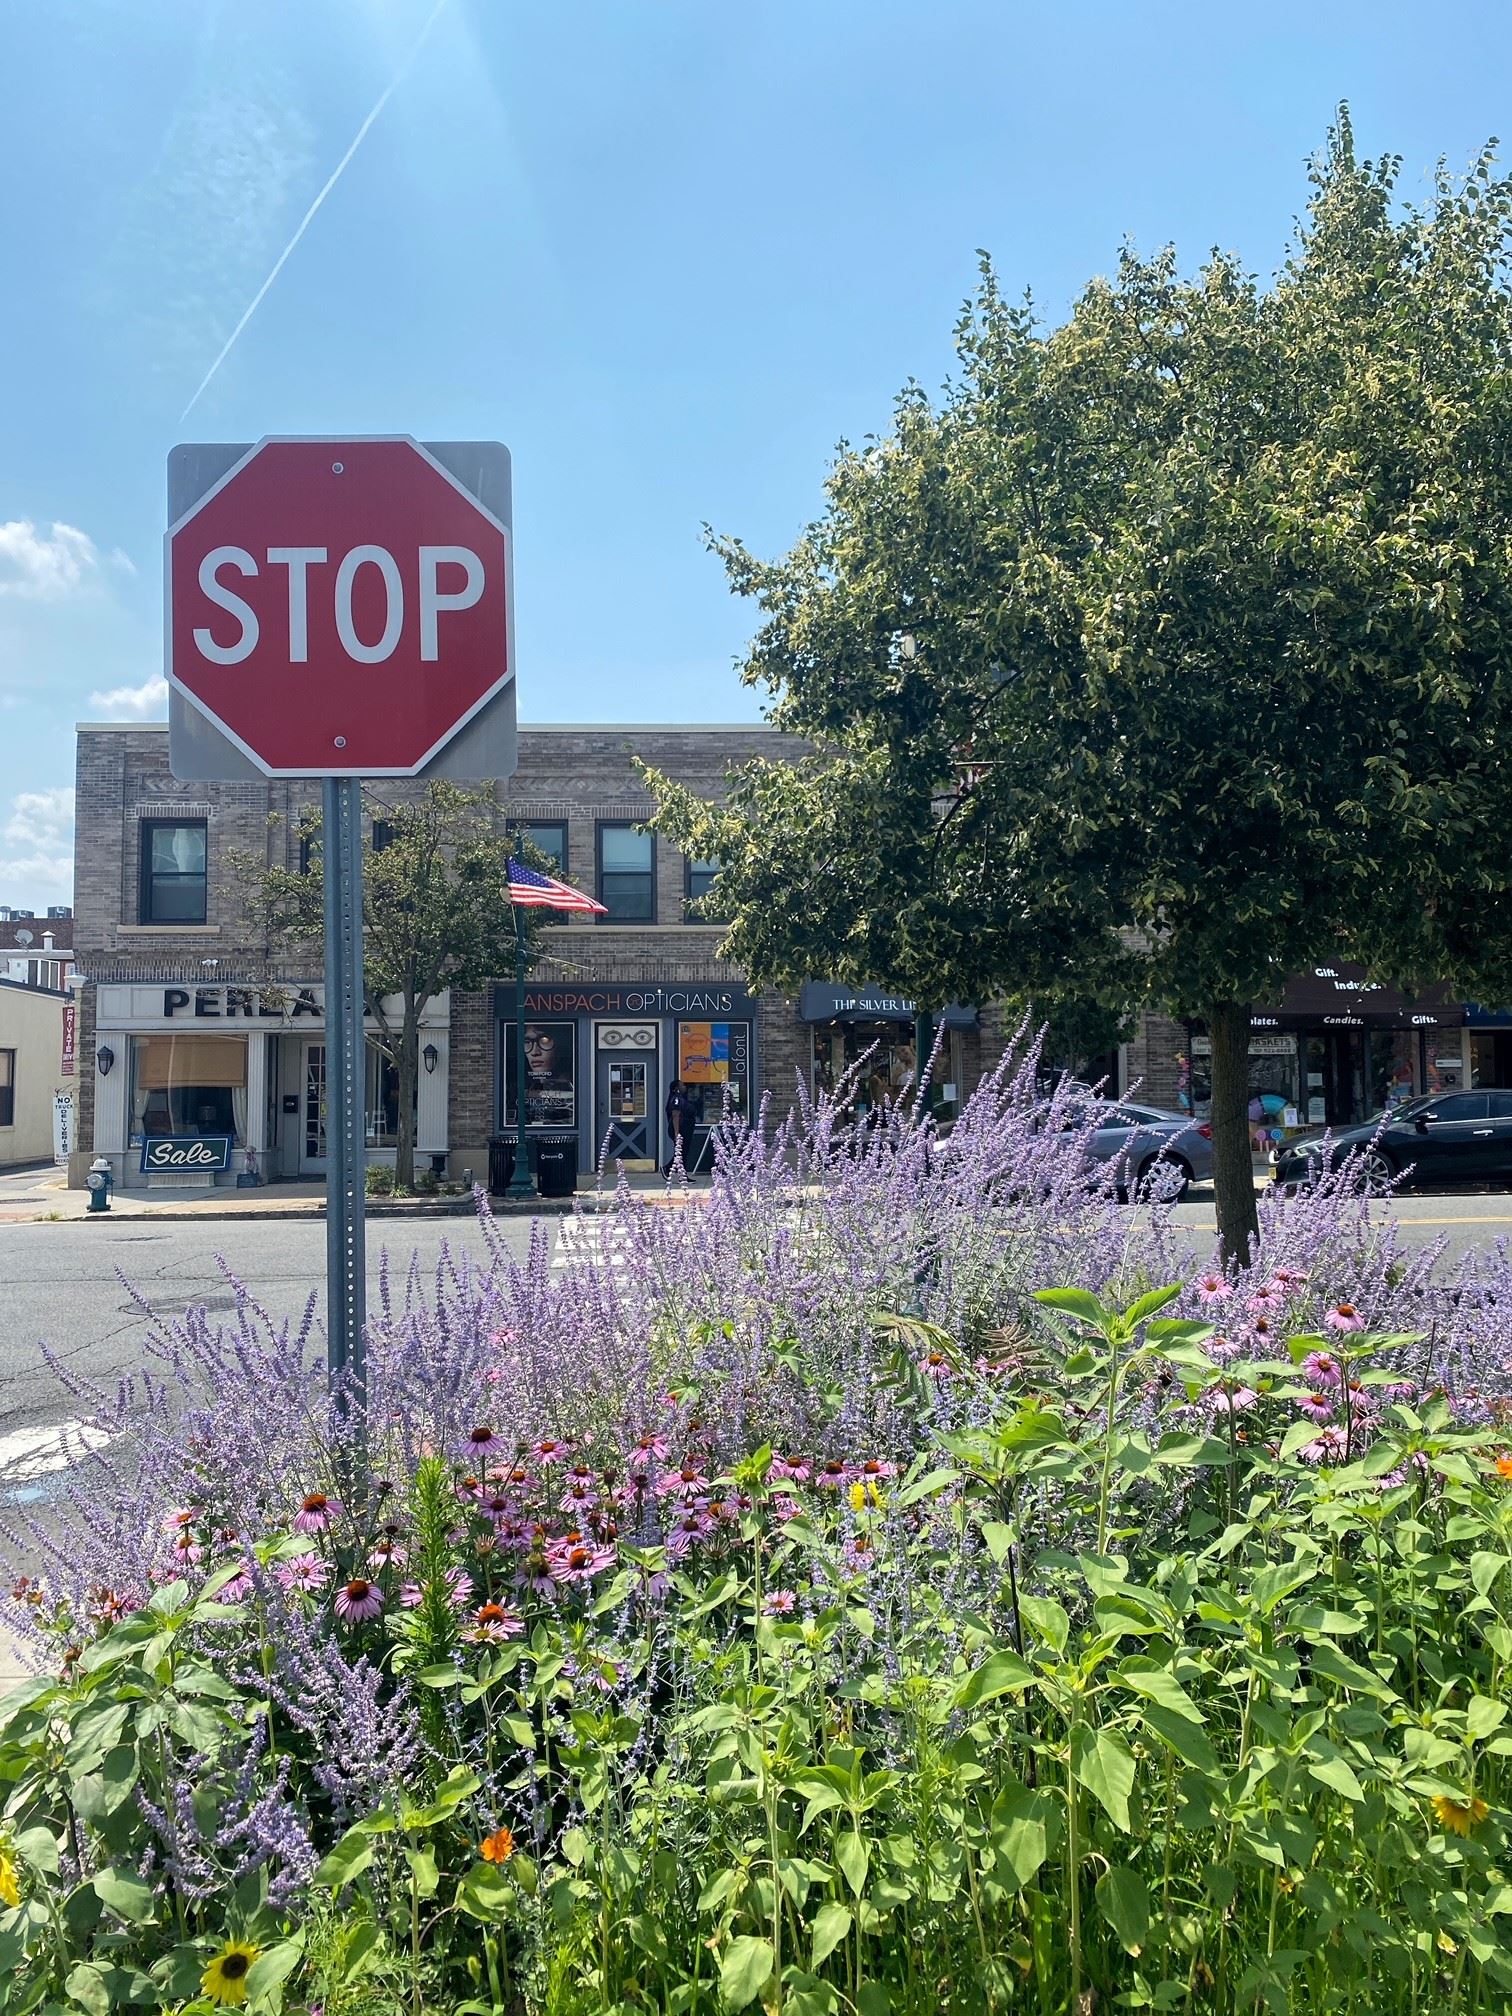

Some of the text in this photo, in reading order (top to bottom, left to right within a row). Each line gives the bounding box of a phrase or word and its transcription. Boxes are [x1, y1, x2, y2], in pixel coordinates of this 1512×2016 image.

[192, 544, 486, 666] STOP
[1314, 967, 1339, 978] Gift.
[1334, 980, 1382, 992] Indue.
[522, 992, 733, 1012] ANSPACH OPTICIANS
[859, 999, 899, 1011] SILVER
[1323, 1016, 1364, 1025] Candies.
[1411, 1015, 1438, 1025] Gifts.
[66, 1008, 74, 1053] PRIVATE
[60, 1109, 68, 1154] DELIVERIES
[148, 1142, 221, 1165] Sale
